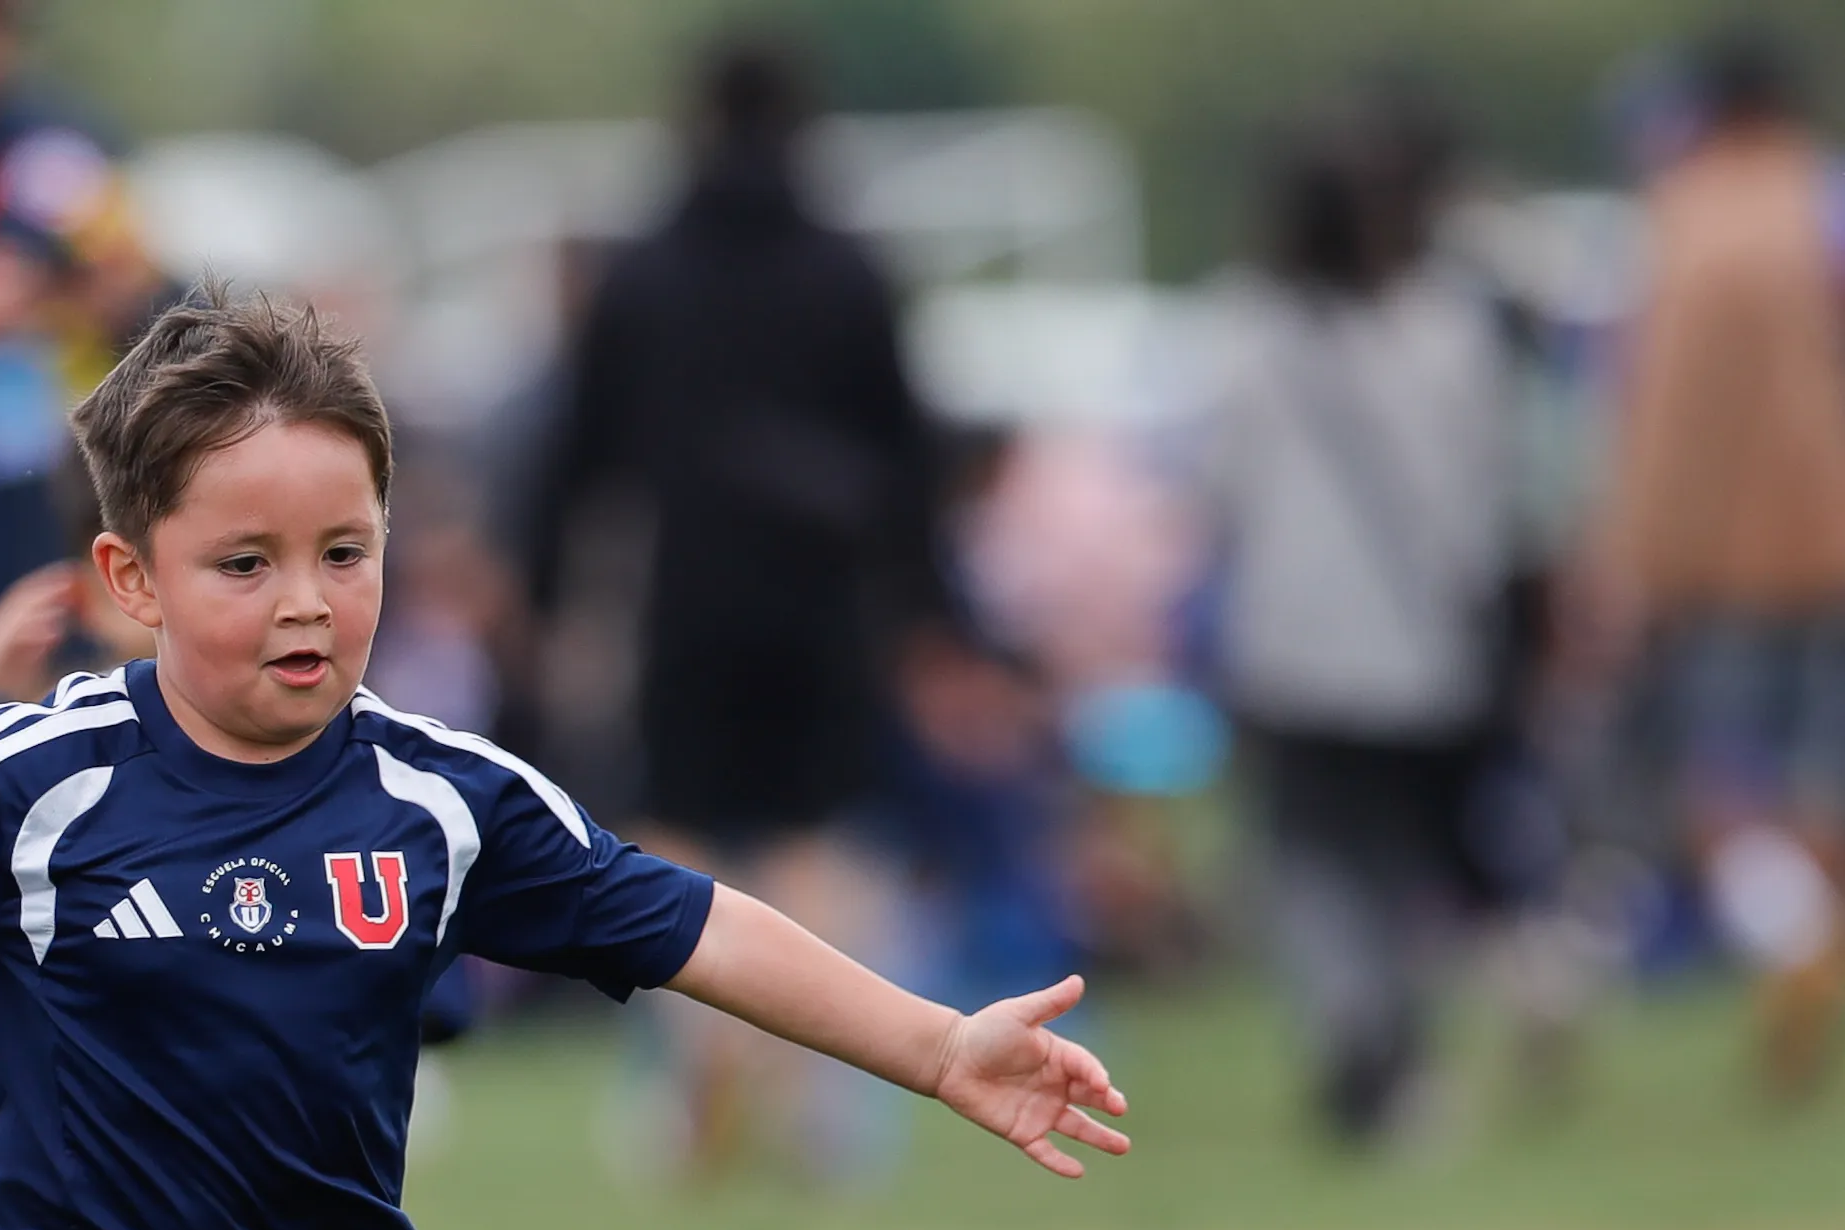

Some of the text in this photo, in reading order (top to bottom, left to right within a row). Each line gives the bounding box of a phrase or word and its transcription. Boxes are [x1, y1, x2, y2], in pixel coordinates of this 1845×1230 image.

[202, 857, 292, 894] ESCUELA OFICIAL
[324, 851, 410, 950] U
